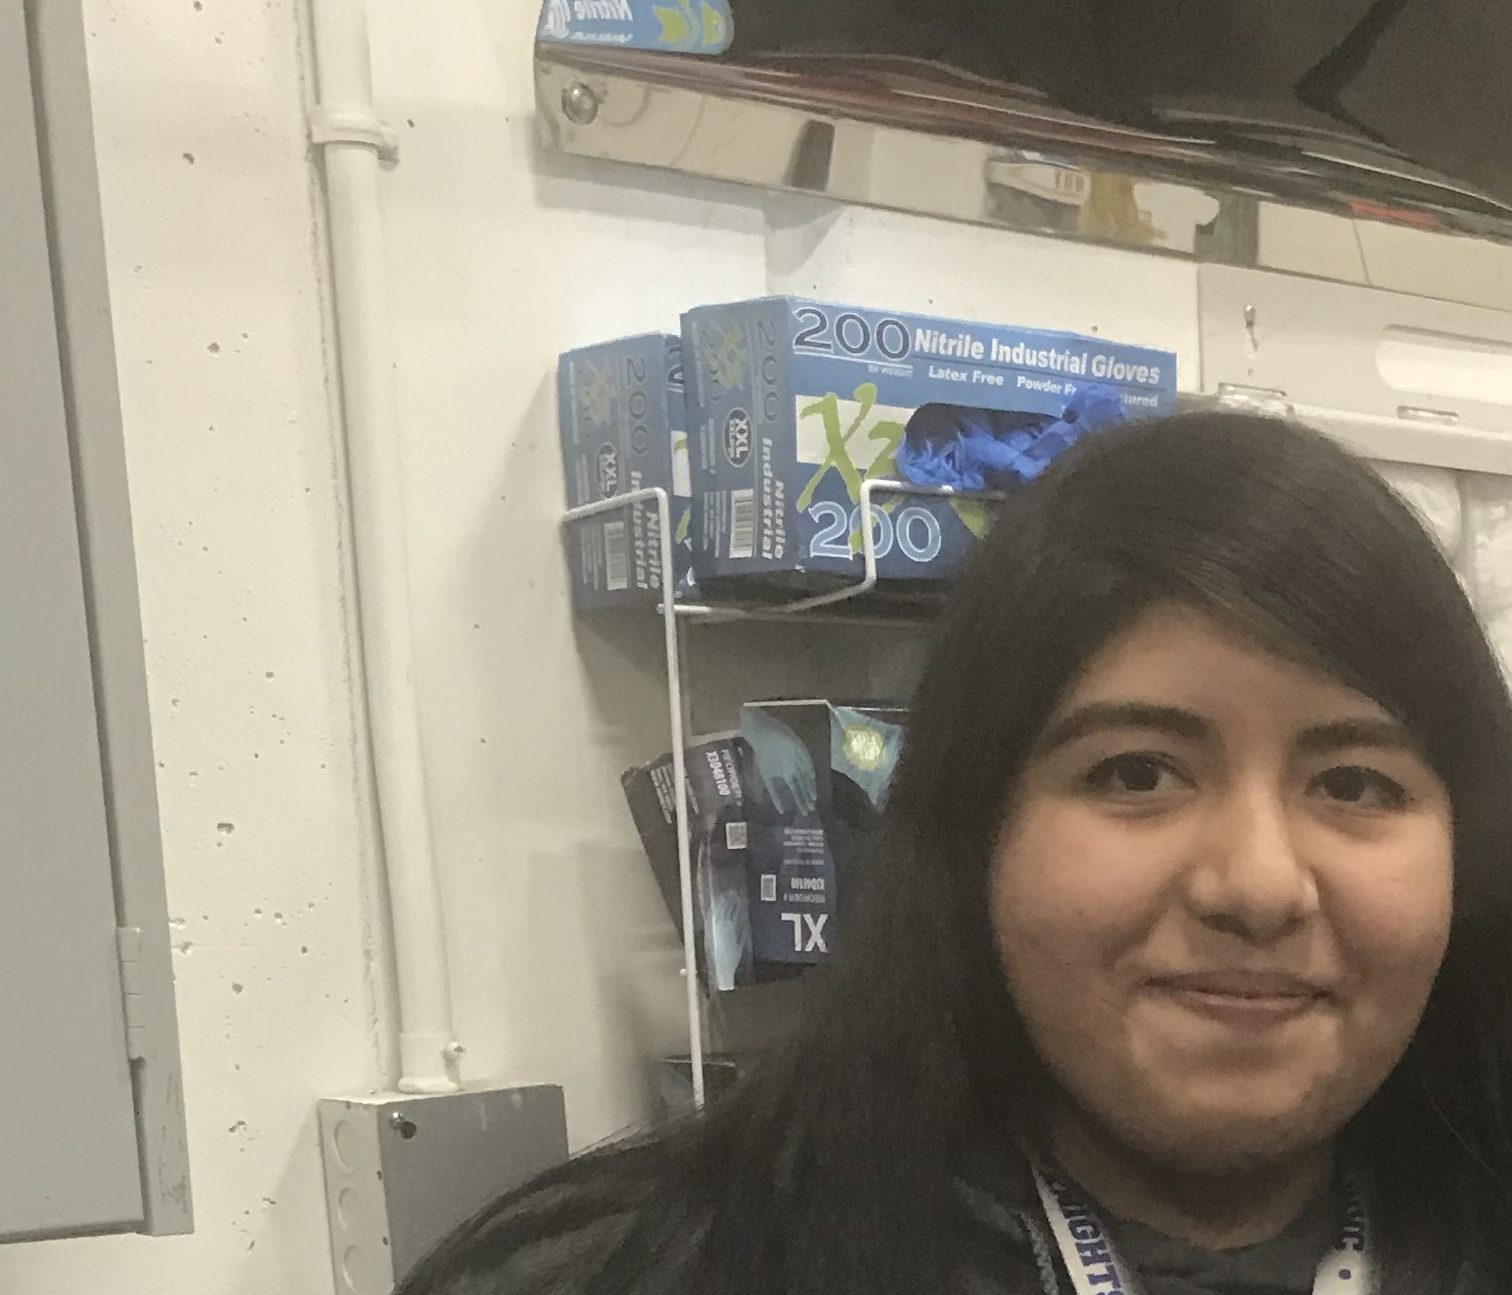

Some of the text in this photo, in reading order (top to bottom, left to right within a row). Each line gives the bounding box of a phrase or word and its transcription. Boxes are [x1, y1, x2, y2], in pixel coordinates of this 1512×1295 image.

[793, 307, 1161, 385] 200 Nitrile Industrial Gloves
[928, 365, 1078, 398] Latex Free Powder Fr
[761, 437, 774, 560] Industrial
[774, 480, 785, 559] Nitrile
[808, 500, 942, 563] 200
[646, 509, 661, 589] Nitrile
[781, 912, 828, 953] XL
